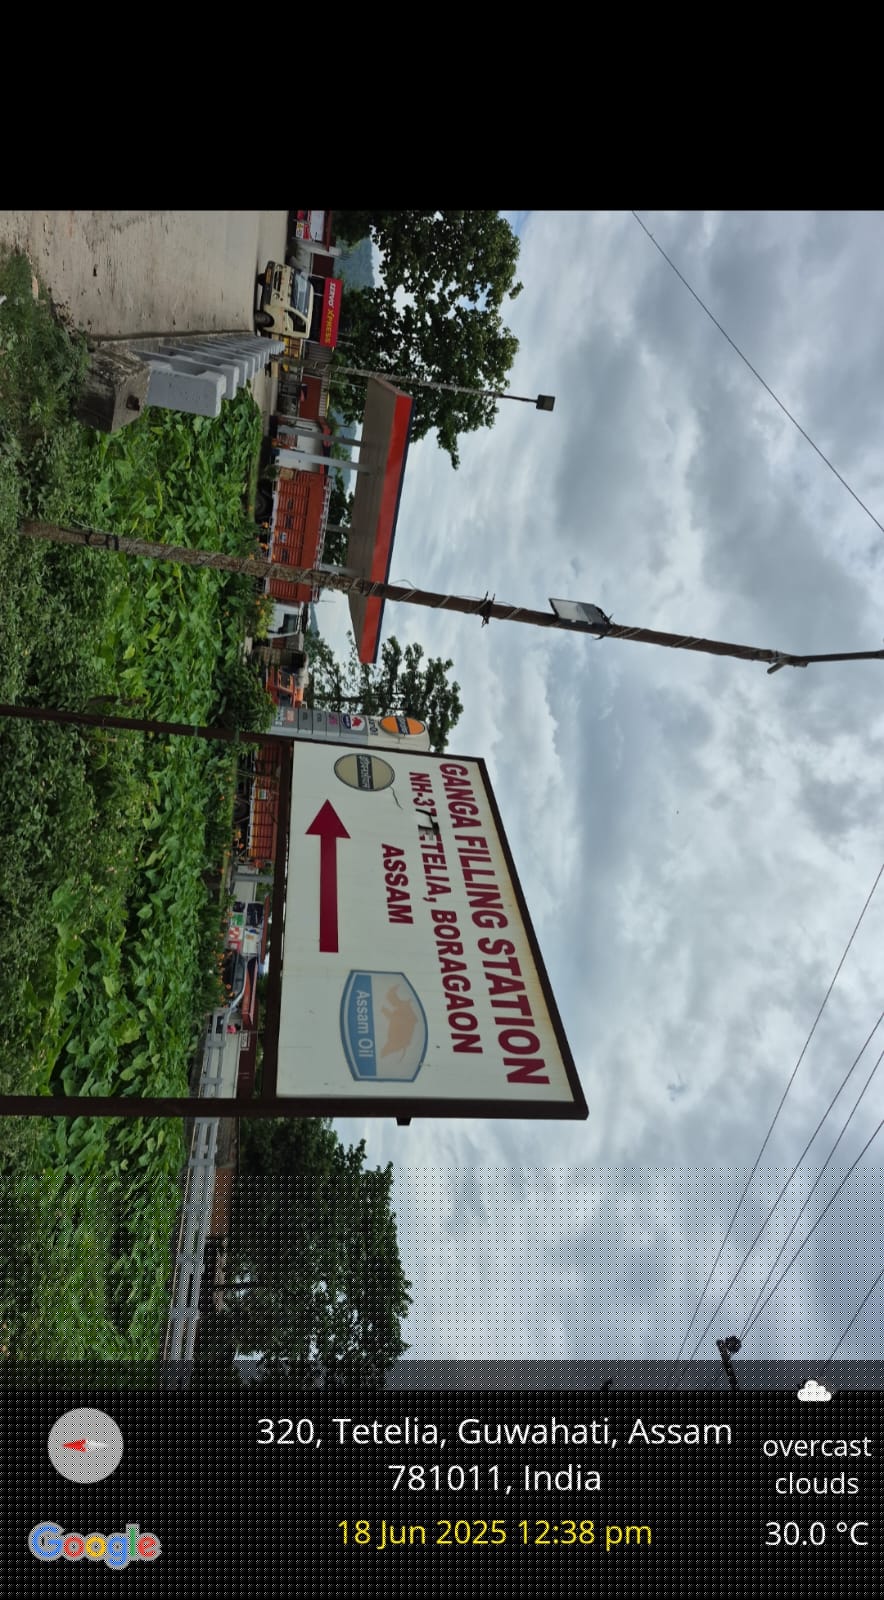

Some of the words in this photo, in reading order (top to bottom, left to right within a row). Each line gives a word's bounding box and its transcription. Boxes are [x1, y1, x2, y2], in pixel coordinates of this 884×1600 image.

[325, 309, 335, 344] XPRESS
[328, 282, 336, 308] SERVO
[440, 762, 481, 828] GANGA
[382, 844, 413, 925] ASSAM
[409, 771, 438, 817] NH-37
[431, 909, 482, 1054] BORAGAON
[457, 834, 508, 930] FILLING
[356, 990, 371, 1034] Assam
[478, 937, 549, 1085] STATION
[358, 1038, 374, 1058] Oil
